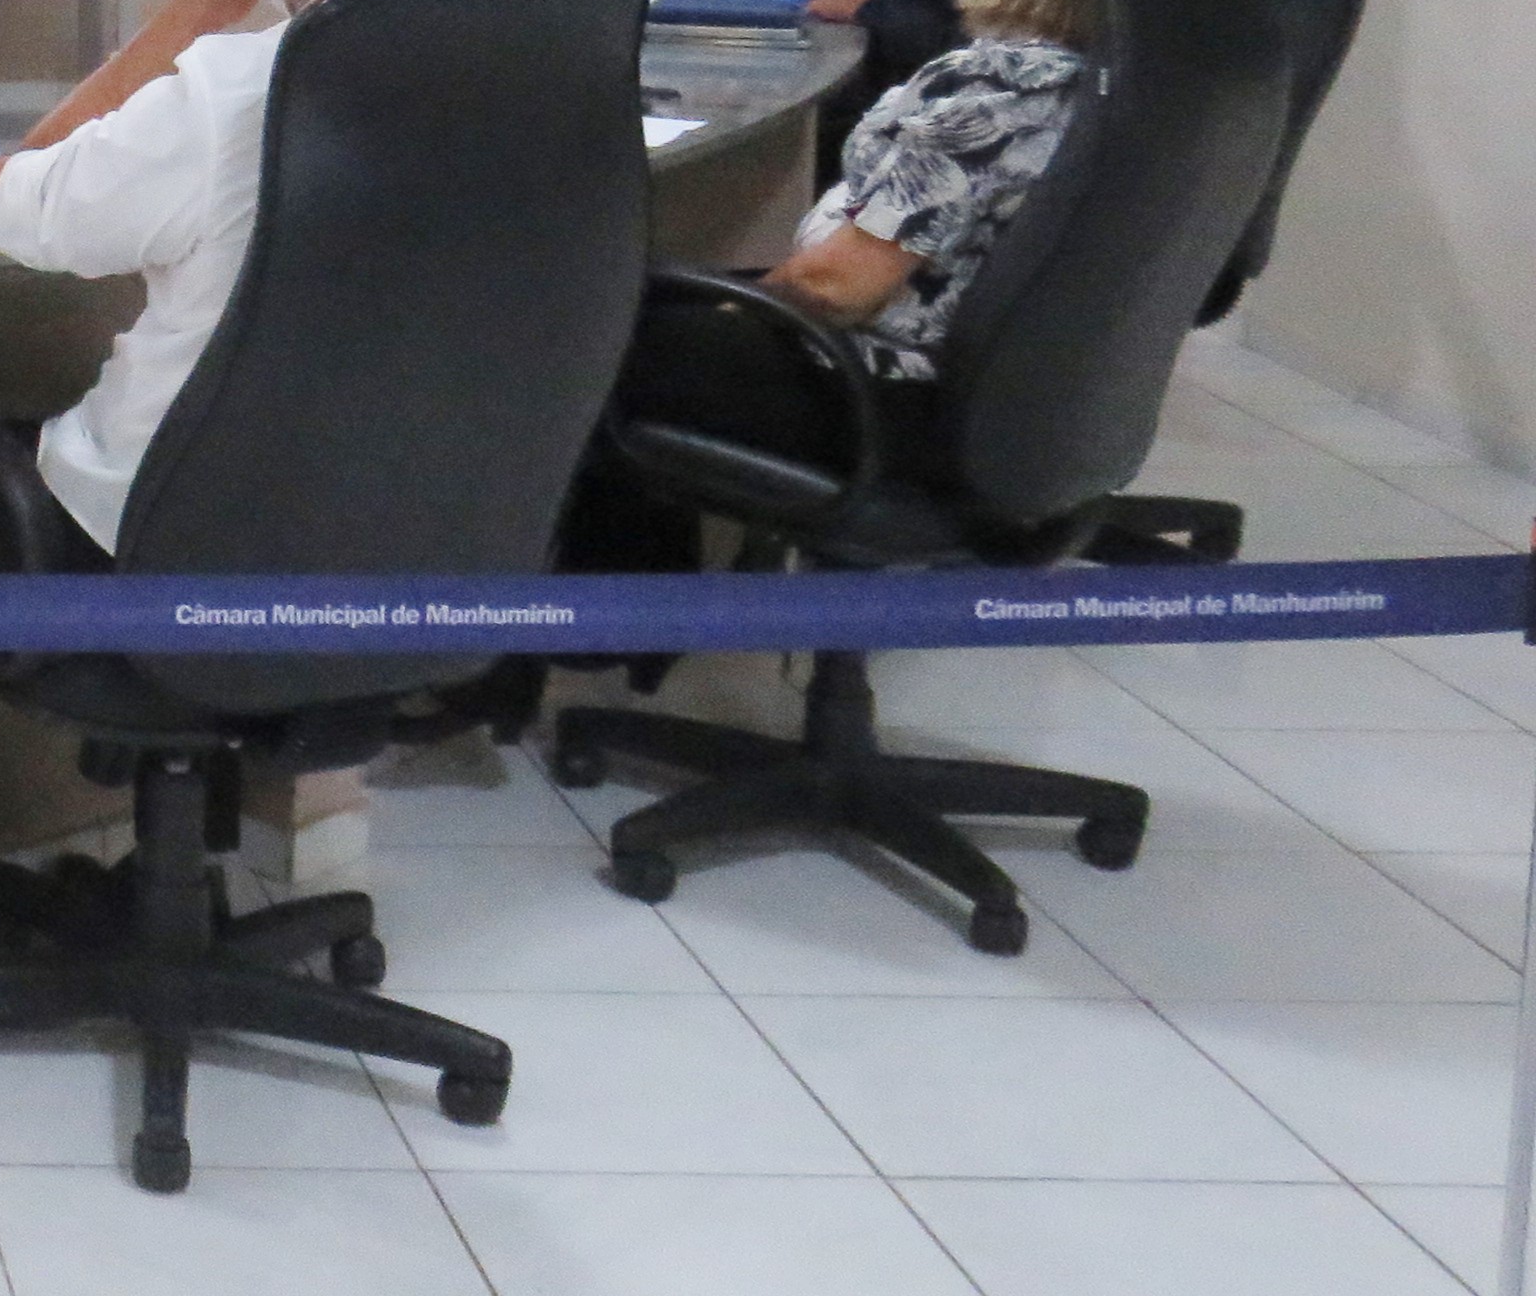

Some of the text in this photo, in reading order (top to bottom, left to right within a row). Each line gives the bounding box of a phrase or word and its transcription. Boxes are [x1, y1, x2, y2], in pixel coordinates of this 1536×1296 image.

[175, 604, 575, 628] Câmara Municipal de Manhumirim
[975, 589, 1386, 620] Câmara Municipal de Manhumirim
